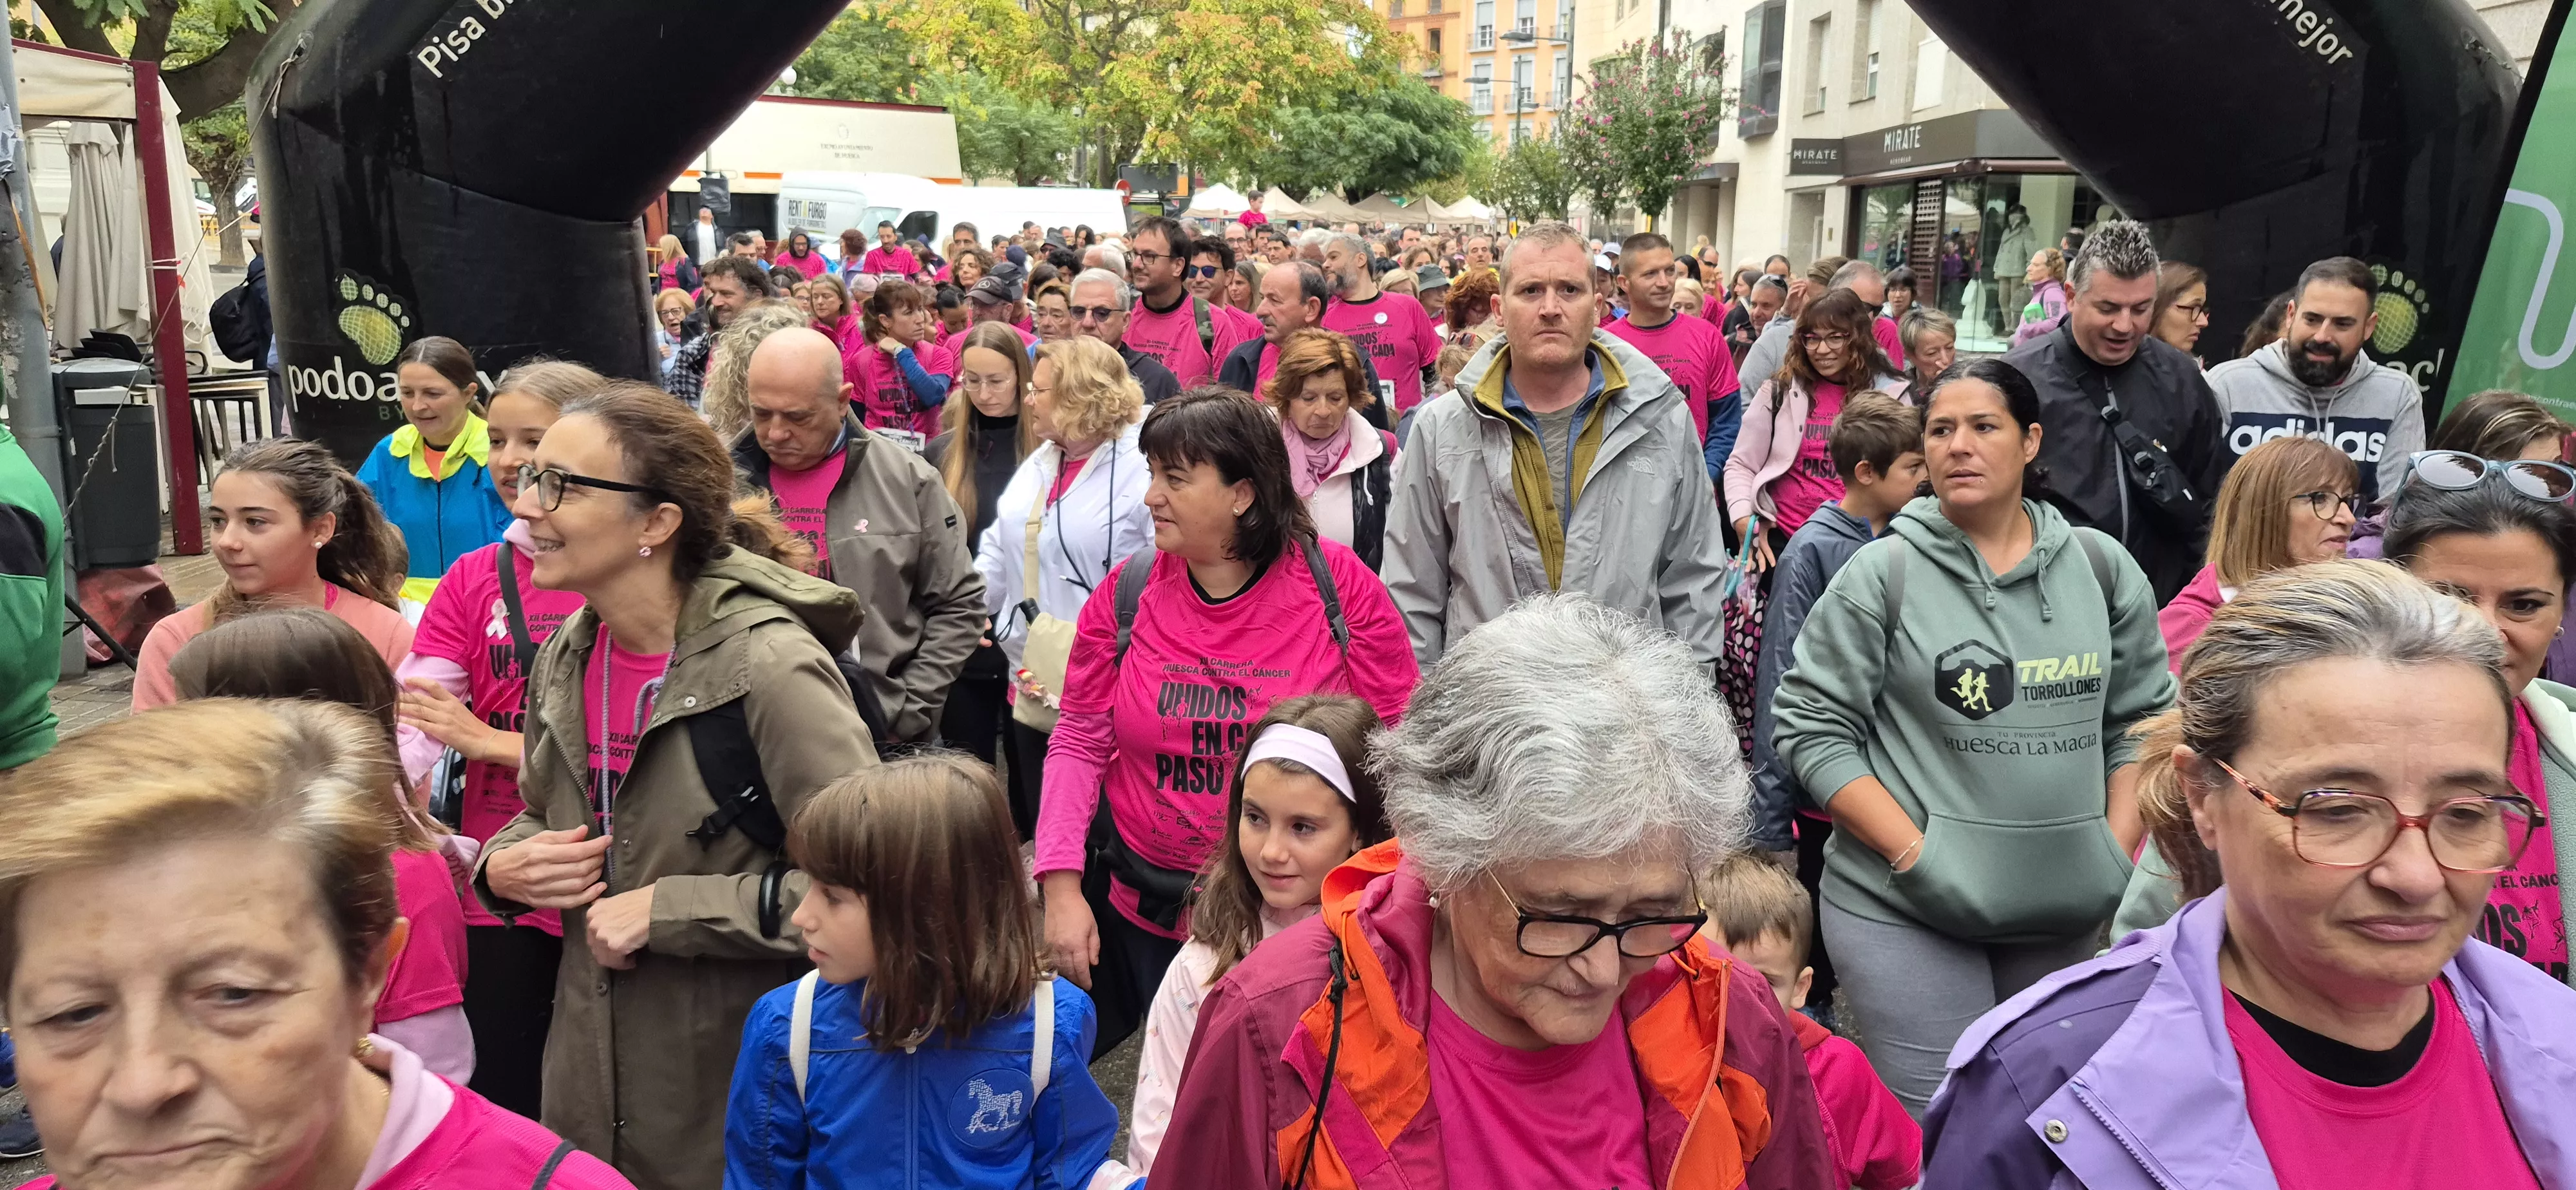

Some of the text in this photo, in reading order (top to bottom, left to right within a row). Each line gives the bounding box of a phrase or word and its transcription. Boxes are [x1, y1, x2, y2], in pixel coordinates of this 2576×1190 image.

[417, 16, 486, 78] Pisa
[1884, 125, 1922, 153] MIRATE
[1793, 149, 1837, 160] MIRATE
[789, 200, 802, 217] RENT
[808, 201, 827, 220] FURGO
[1372, 344, 1395, 357] CADA
[2230, 418, 2387, 462] adidas
[1803, 458, 1837, 479] PASO
[1163, 664, 1199, 675] HUESCA
[1202, 667, 1236, 677] CONTRA
[1252, 667, 1291, 677] CÁNCER
[1211, 657, 1254, 669] CARRERA
[2017, 652, 2103, 683] TRAIL
[1157, 681, 1247, 721] UNIDOS
[2022, 677, 2101, 702] TORROLLONES
[1192, 721, 1222, 756] EN
[1155, 753, 1224, 795] PASO
[2500, 873, 2561, 888] EL CÁNC
